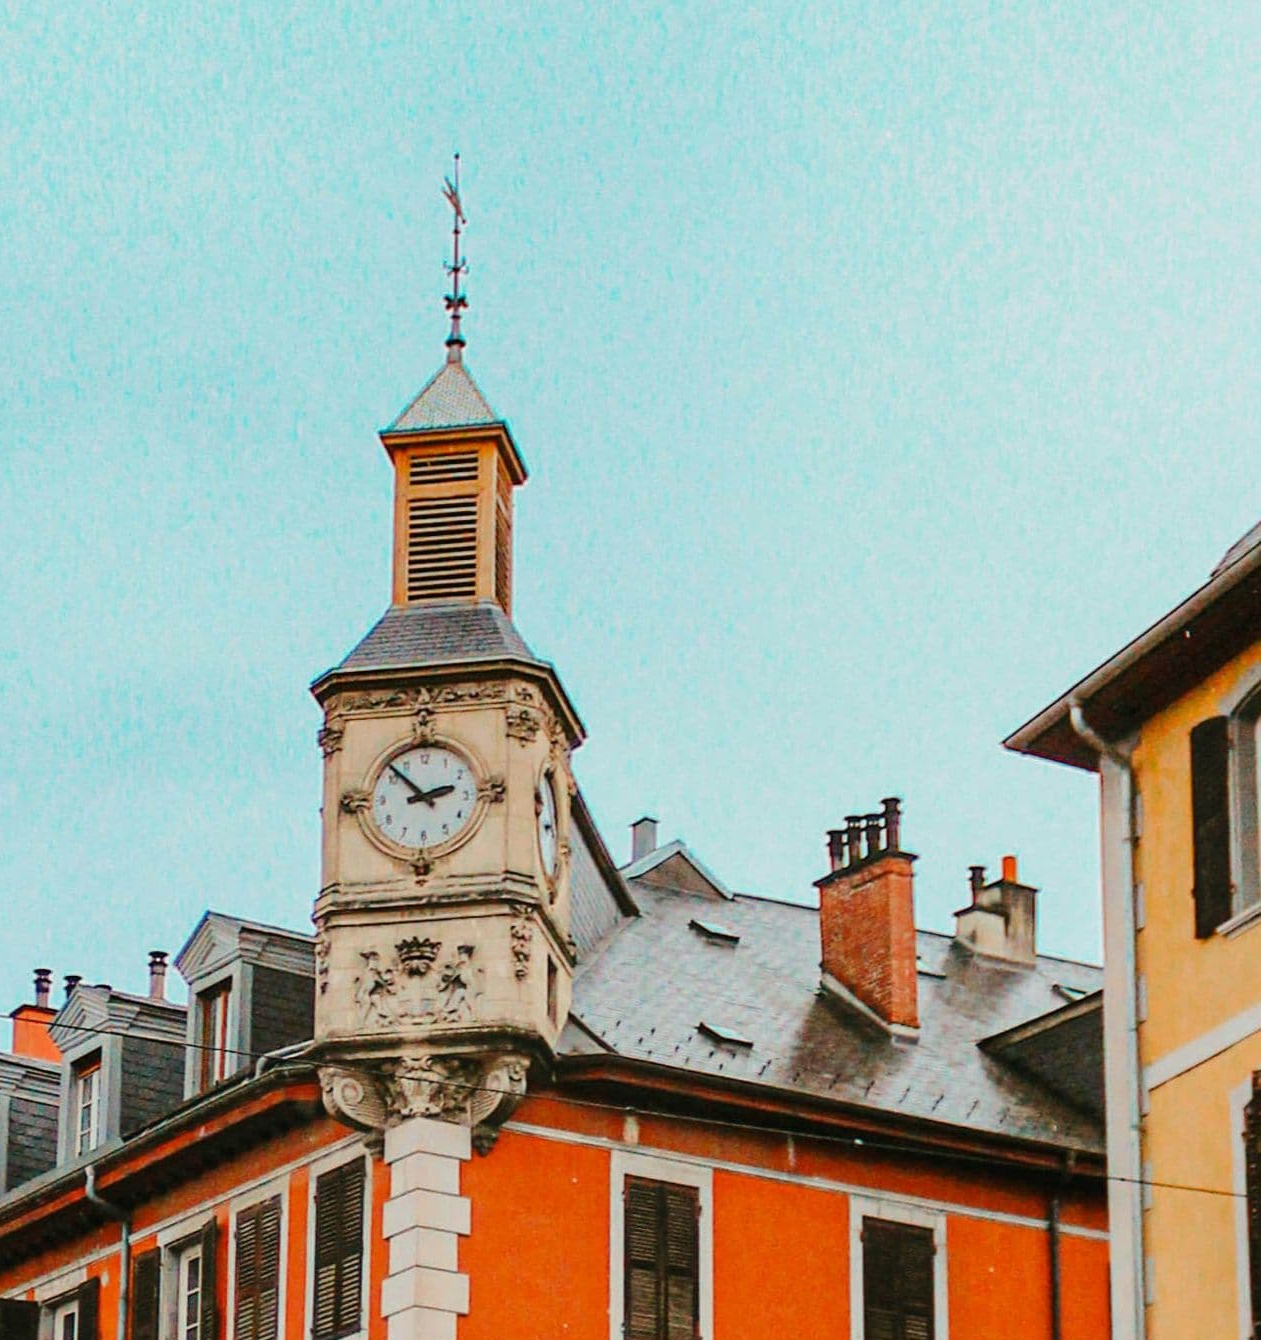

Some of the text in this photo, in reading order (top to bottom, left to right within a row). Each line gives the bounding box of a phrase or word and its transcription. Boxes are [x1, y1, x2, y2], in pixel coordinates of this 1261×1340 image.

[420, 754, 431, 765] 12
[456, 768, 464, 780] 2
[463, 790, 470, 801] 3
[400, 826, 408, 838] 7
[442, 823, 450, 835] 5
